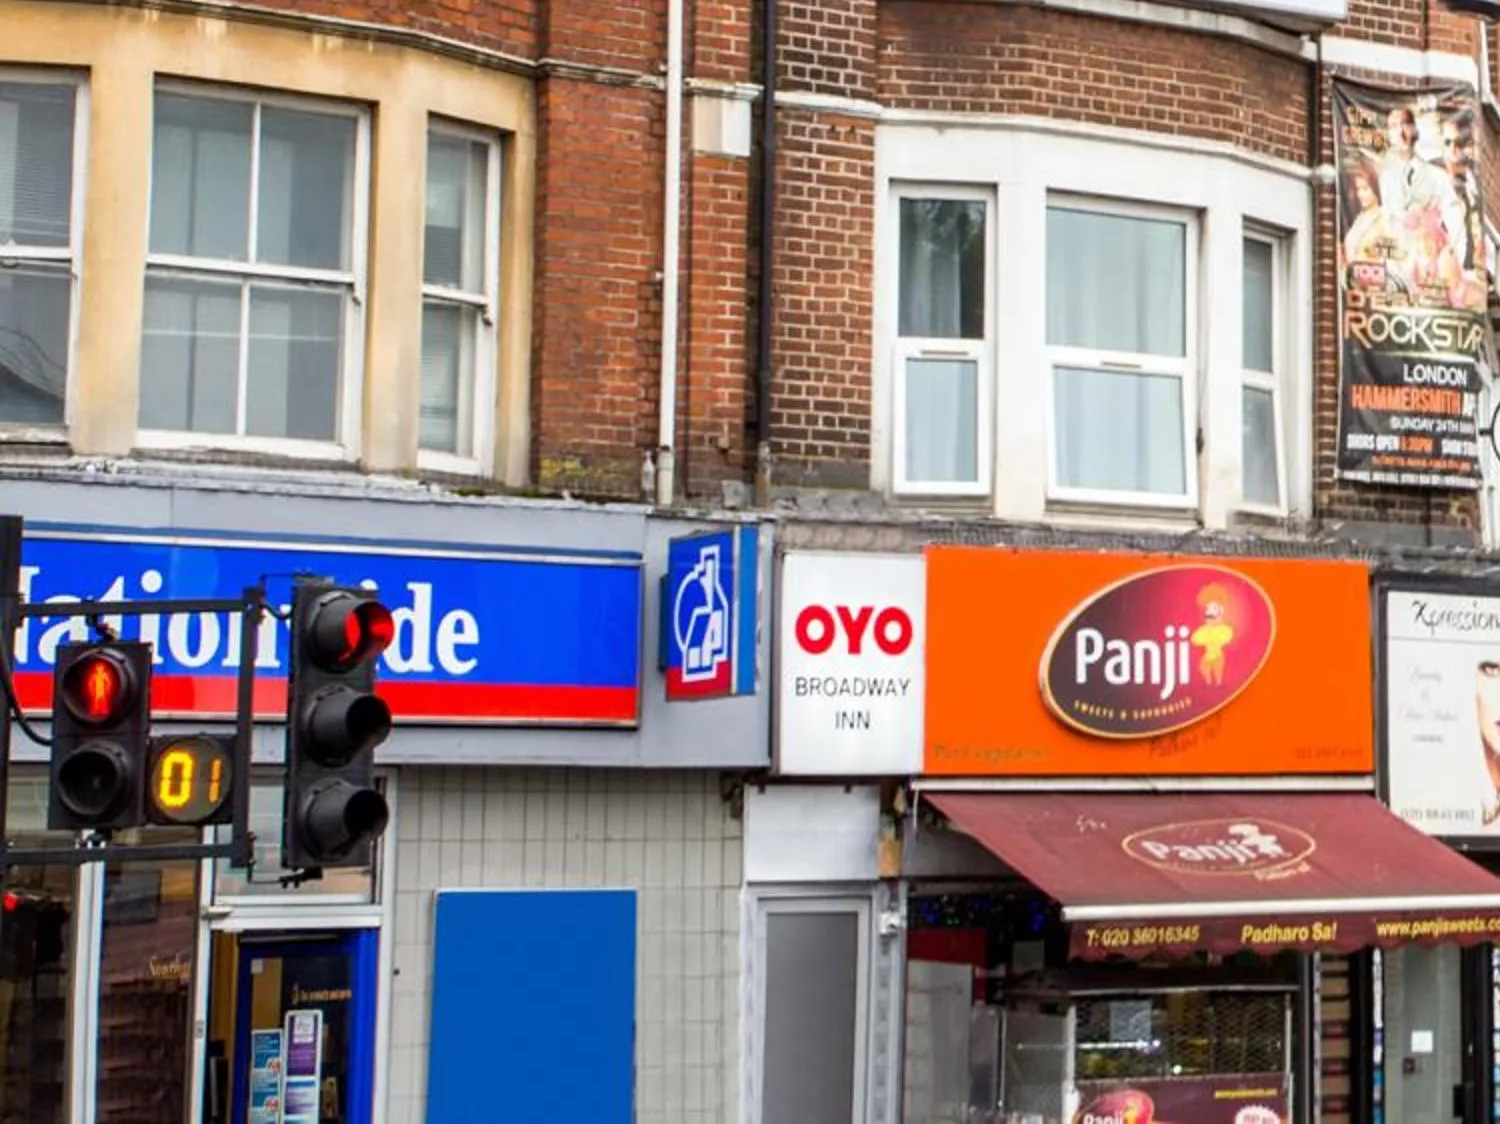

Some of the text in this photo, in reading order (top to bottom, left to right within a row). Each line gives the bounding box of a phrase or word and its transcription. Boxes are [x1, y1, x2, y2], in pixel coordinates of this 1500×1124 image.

[1403, 363, 1467, 386] LONDON
[1351, 383, 1462, 414] HAMMERSMITH
[795, 604, 913, 656] OYO
[1076, 626, 1190, 700] Panji
[795, 677, 911, 697] BROADWAY
[835, 711, 870, 729] INN
[1141, 839, 1256, 864] Panji
[1102, 927, 1129, 946] 020
[1241, 924, 1306, 943] Padharo
